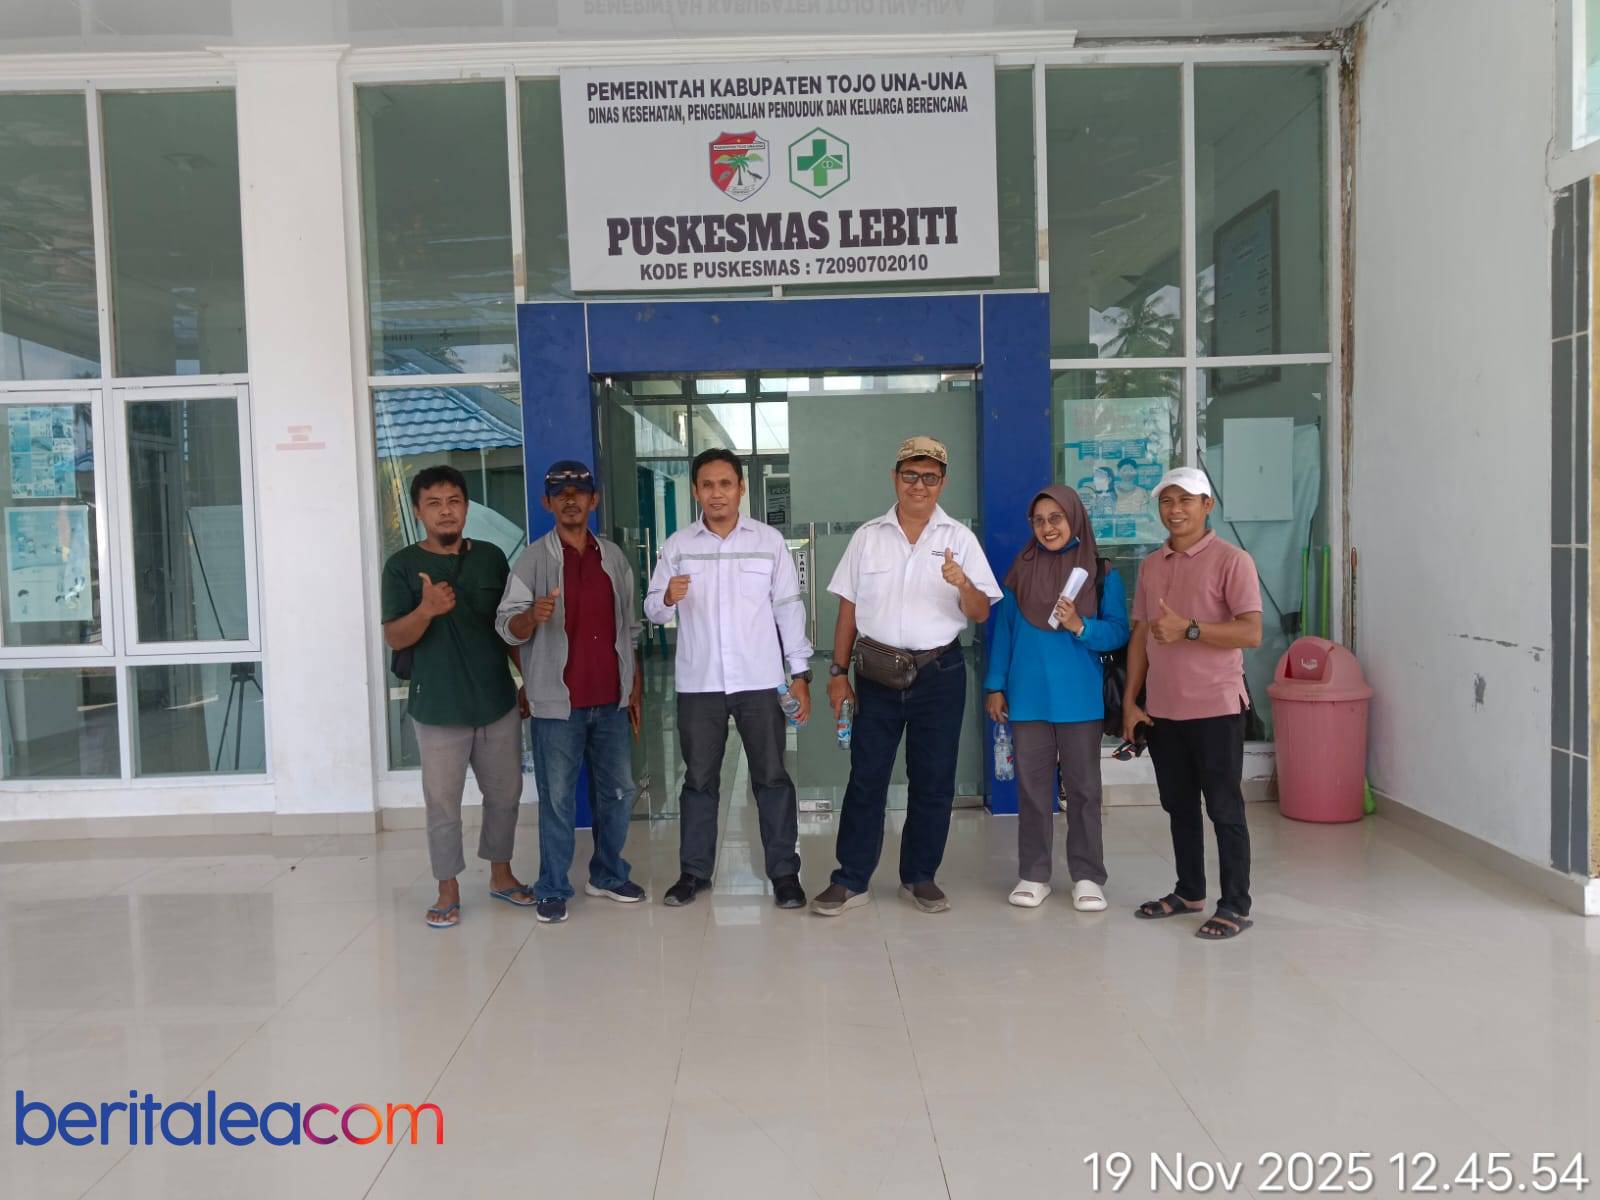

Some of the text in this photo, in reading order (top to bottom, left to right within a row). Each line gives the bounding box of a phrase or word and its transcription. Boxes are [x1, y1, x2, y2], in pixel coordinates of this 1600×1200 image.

[587, 71, 968, 101] PEMERINTAH KABUPATEN TOJO UNA-UNA
[588, 95, 968, 125] DINAS KESEHATAN, PENGENDALIAN PENDUDUK DAN KELUARGA BERENCANA
[607, 206, 958, 256] PUSKESMAS LEBITI
[640, 253, 929, 281] KODE PUSKESMAS : 72090702010
